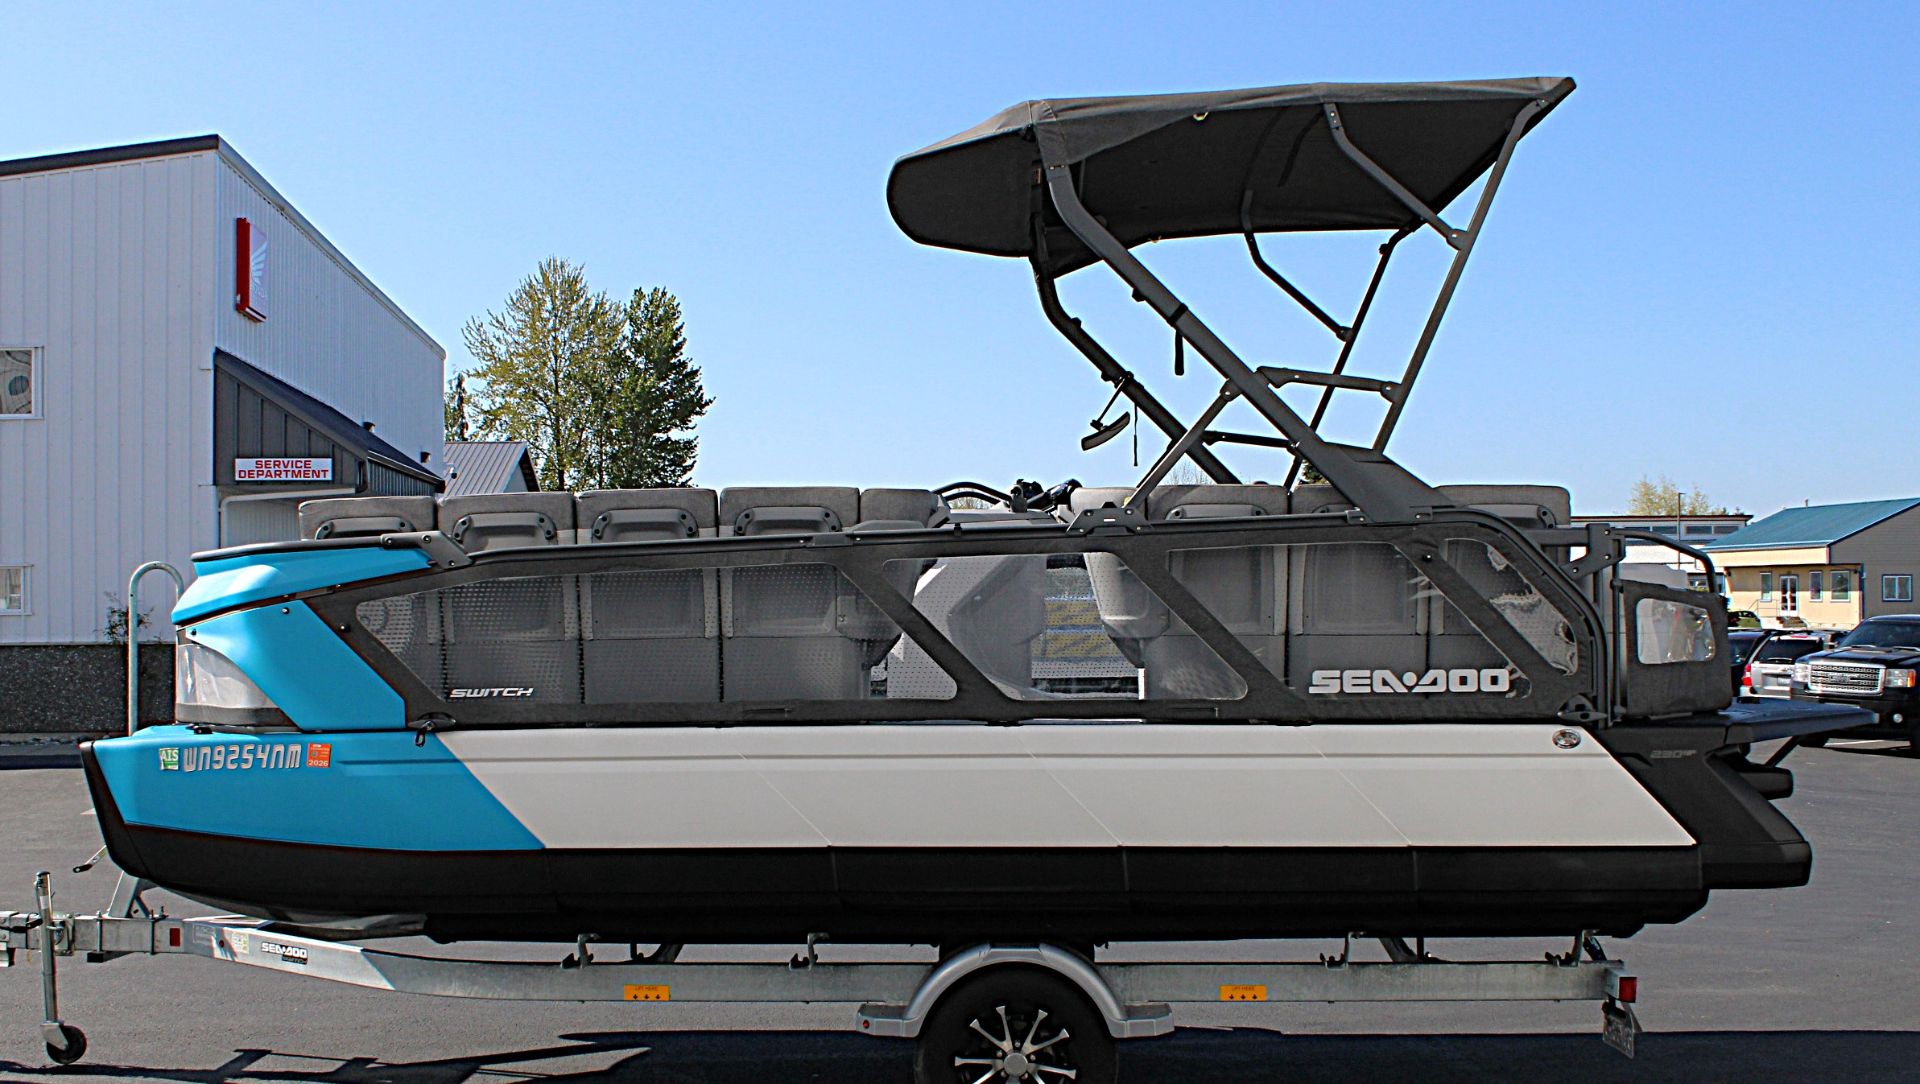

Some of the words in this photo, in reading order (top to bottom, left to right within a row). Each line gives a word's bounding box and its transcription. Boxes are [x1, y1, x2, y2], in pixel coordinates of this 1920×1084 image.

[255, 460, 312, 469] SERVICE
[238, 470, 329, 479] DEPARTMENT
[450, 687, 534, 698] SWITCH
